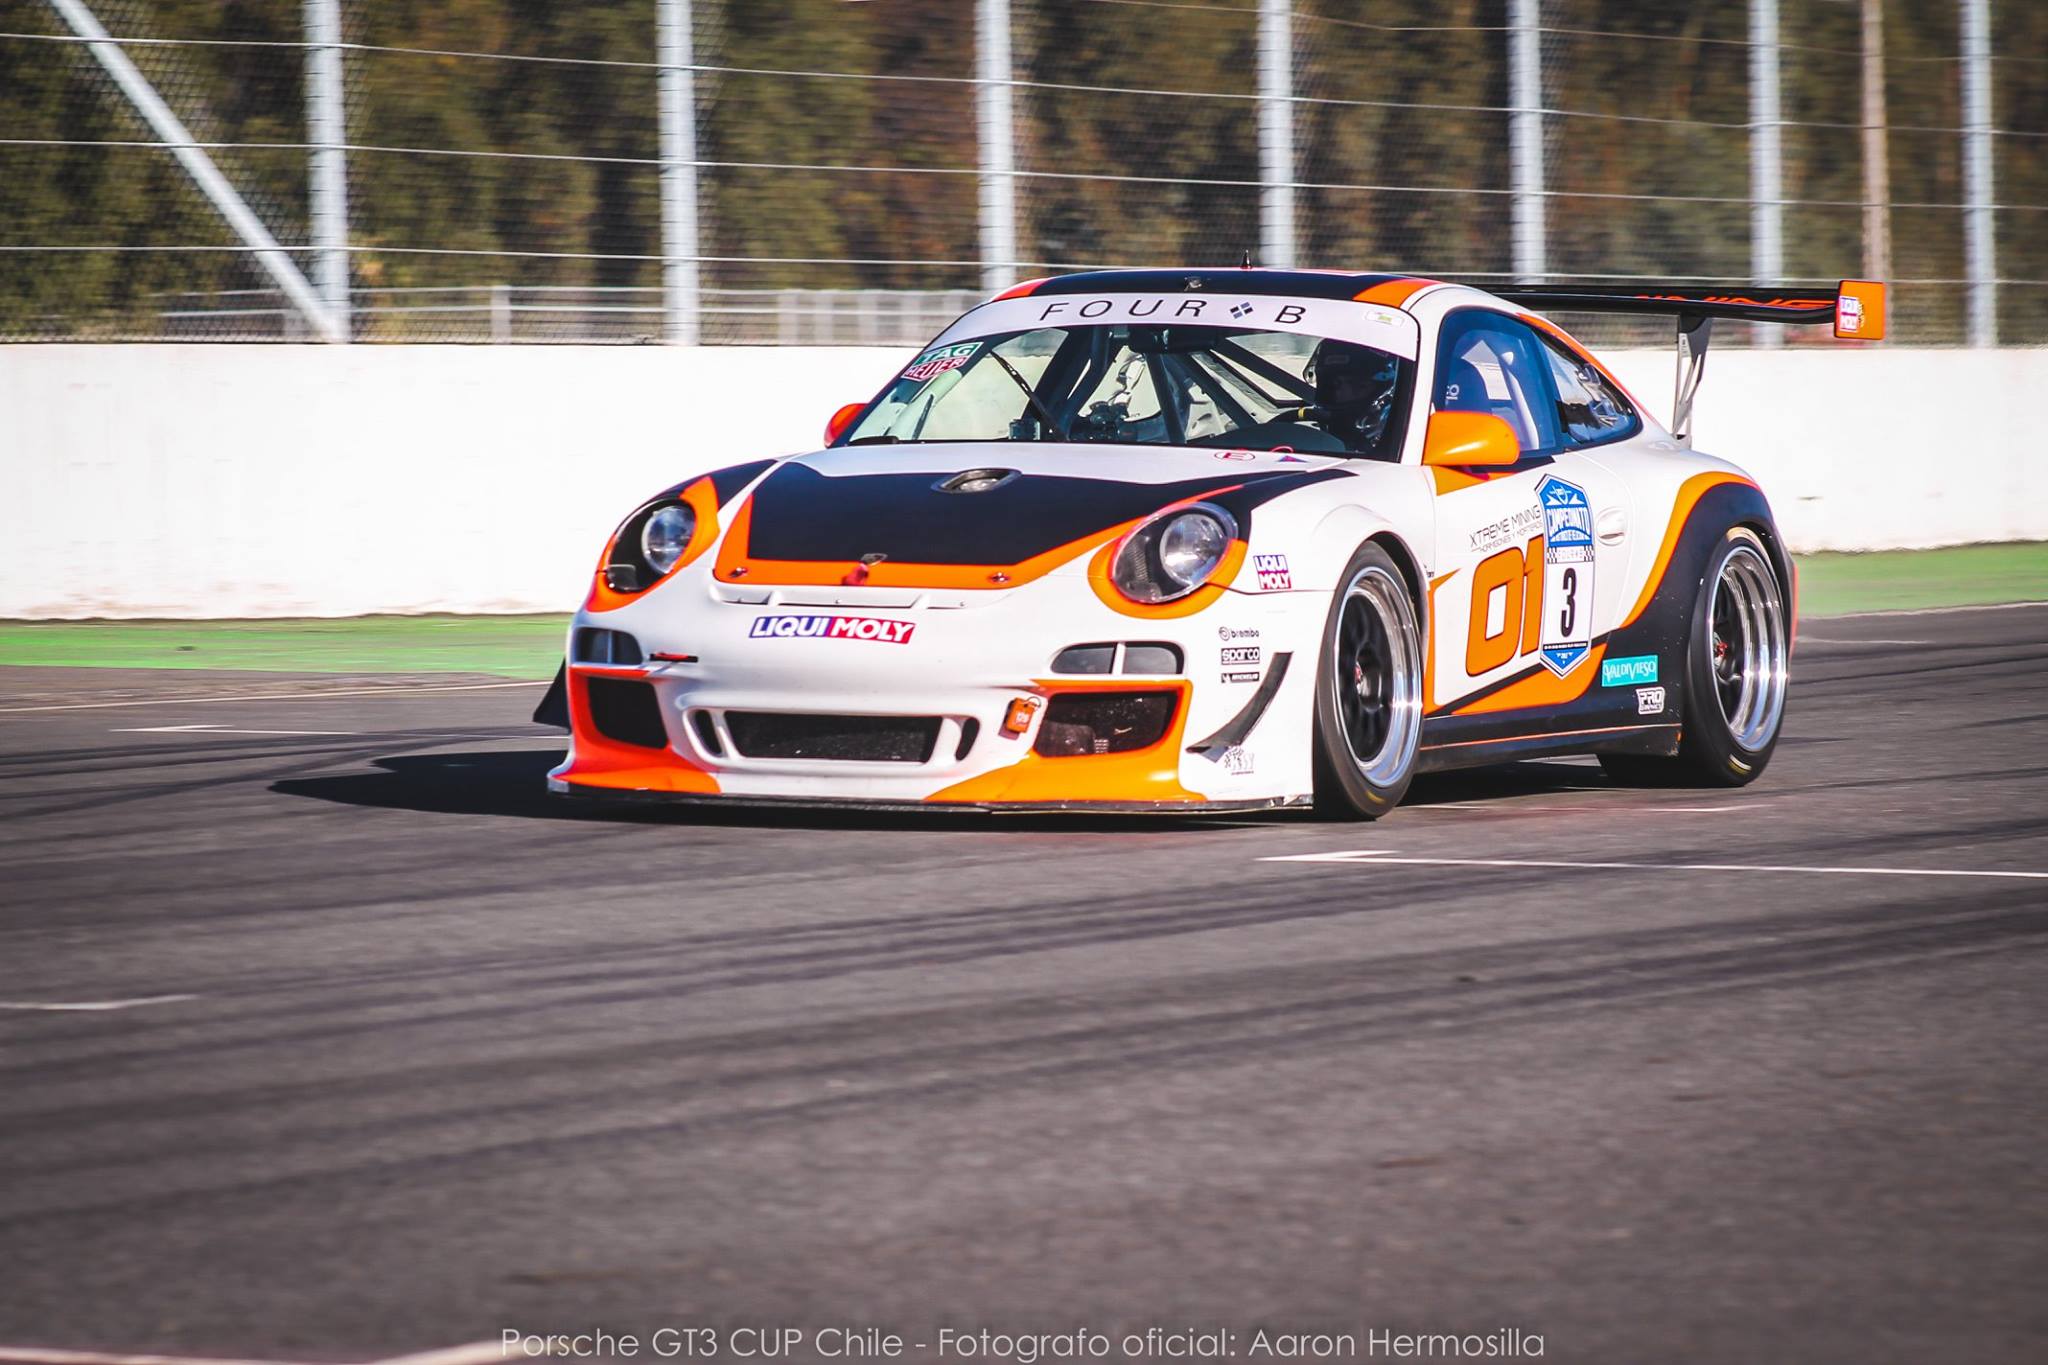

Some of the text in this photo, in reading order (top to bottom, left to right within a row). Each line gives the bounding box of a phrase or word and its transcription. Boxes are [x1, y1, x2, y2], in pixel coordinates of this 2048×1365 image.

[1040, 299, 1307, 325] FOUR B
[921, 344, 976, 362] TAG
[903, 358, 966, 379] HEUER
[1469, 504, 1541, 547] XTREME MINING
[1255, 556, 1288, 572] LIQUI
[1259, 572, 1292, 589] MOLY
[1465, 533, 1544, 677] 01
[1560, 567, 1577, 637] 3
[752, 617, 915, 642] LIQUI MOLY
[1231, 628, 1260, 638] brembo
[1222, 648, 1259, 663] sparco
[1602, 661, 1657, 683] VALDIVIESO
[1639, 690, 1662, 705] PRO
